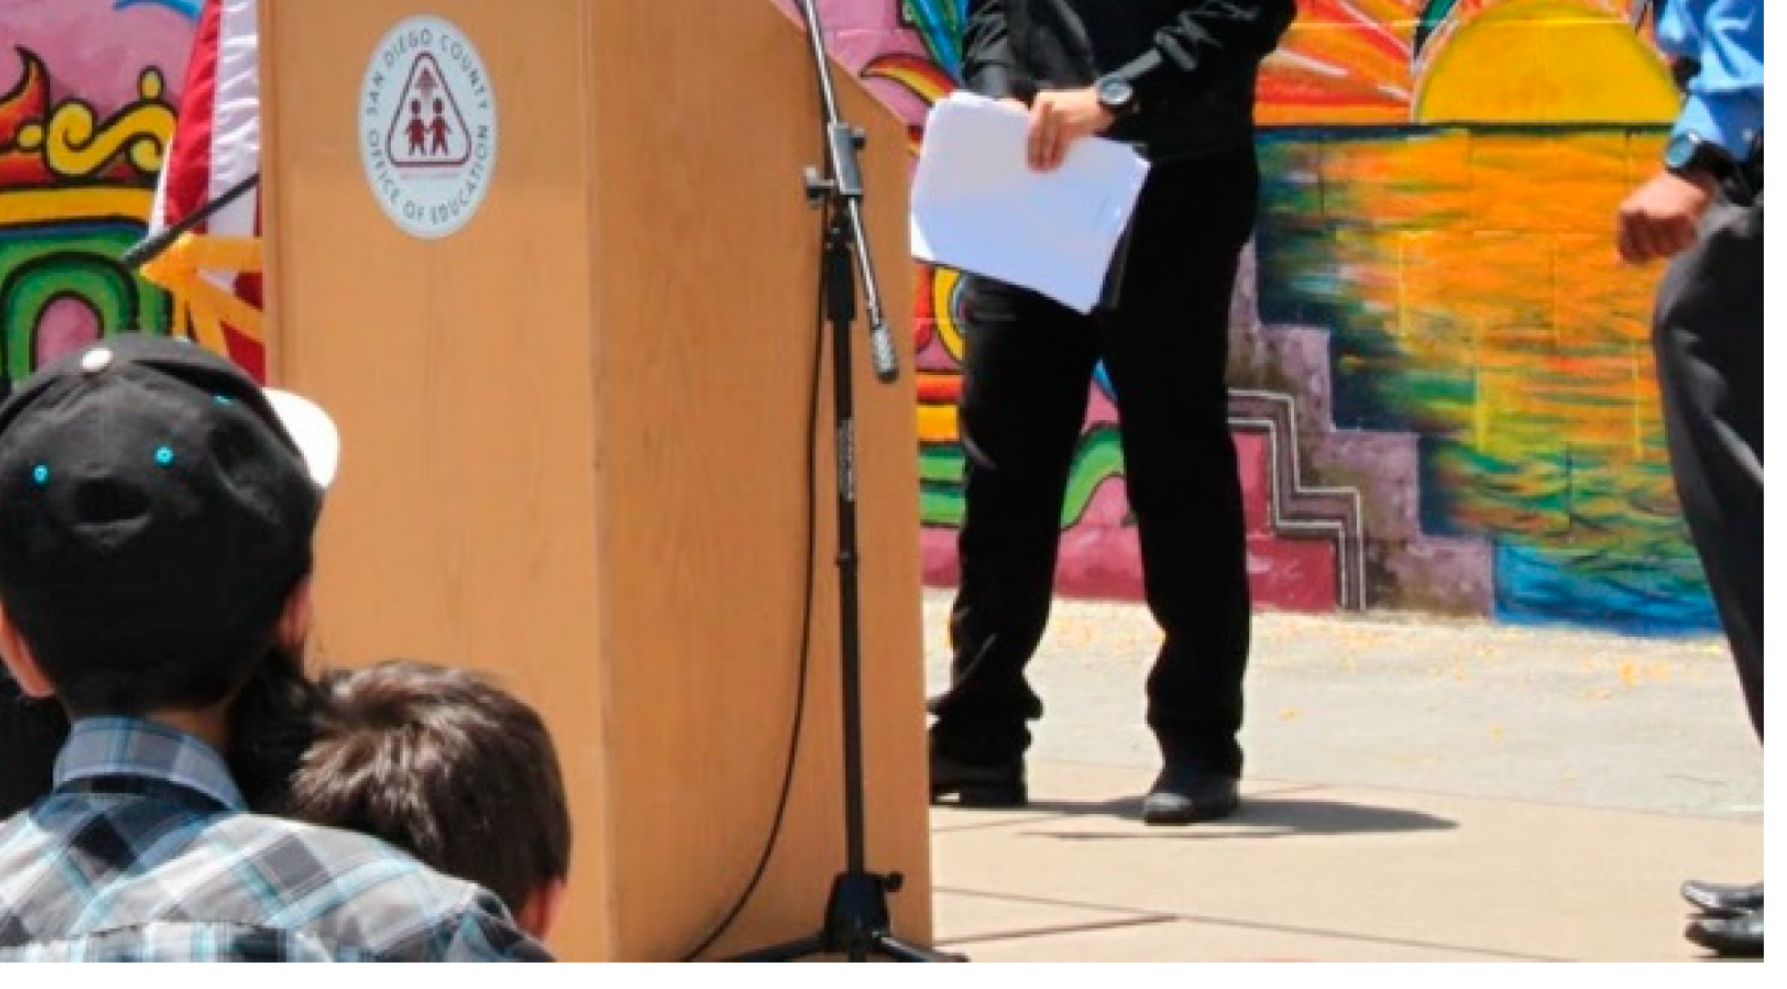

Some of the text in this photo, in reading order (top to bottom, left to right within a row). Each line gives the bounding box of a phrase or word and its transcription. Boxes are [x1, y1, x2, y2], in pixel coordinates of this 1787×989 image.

[366, 27, 488, 116] SAN DIEGO COUNTY
[367, 124, 490, 225] OFFICE OF EDUCATION
